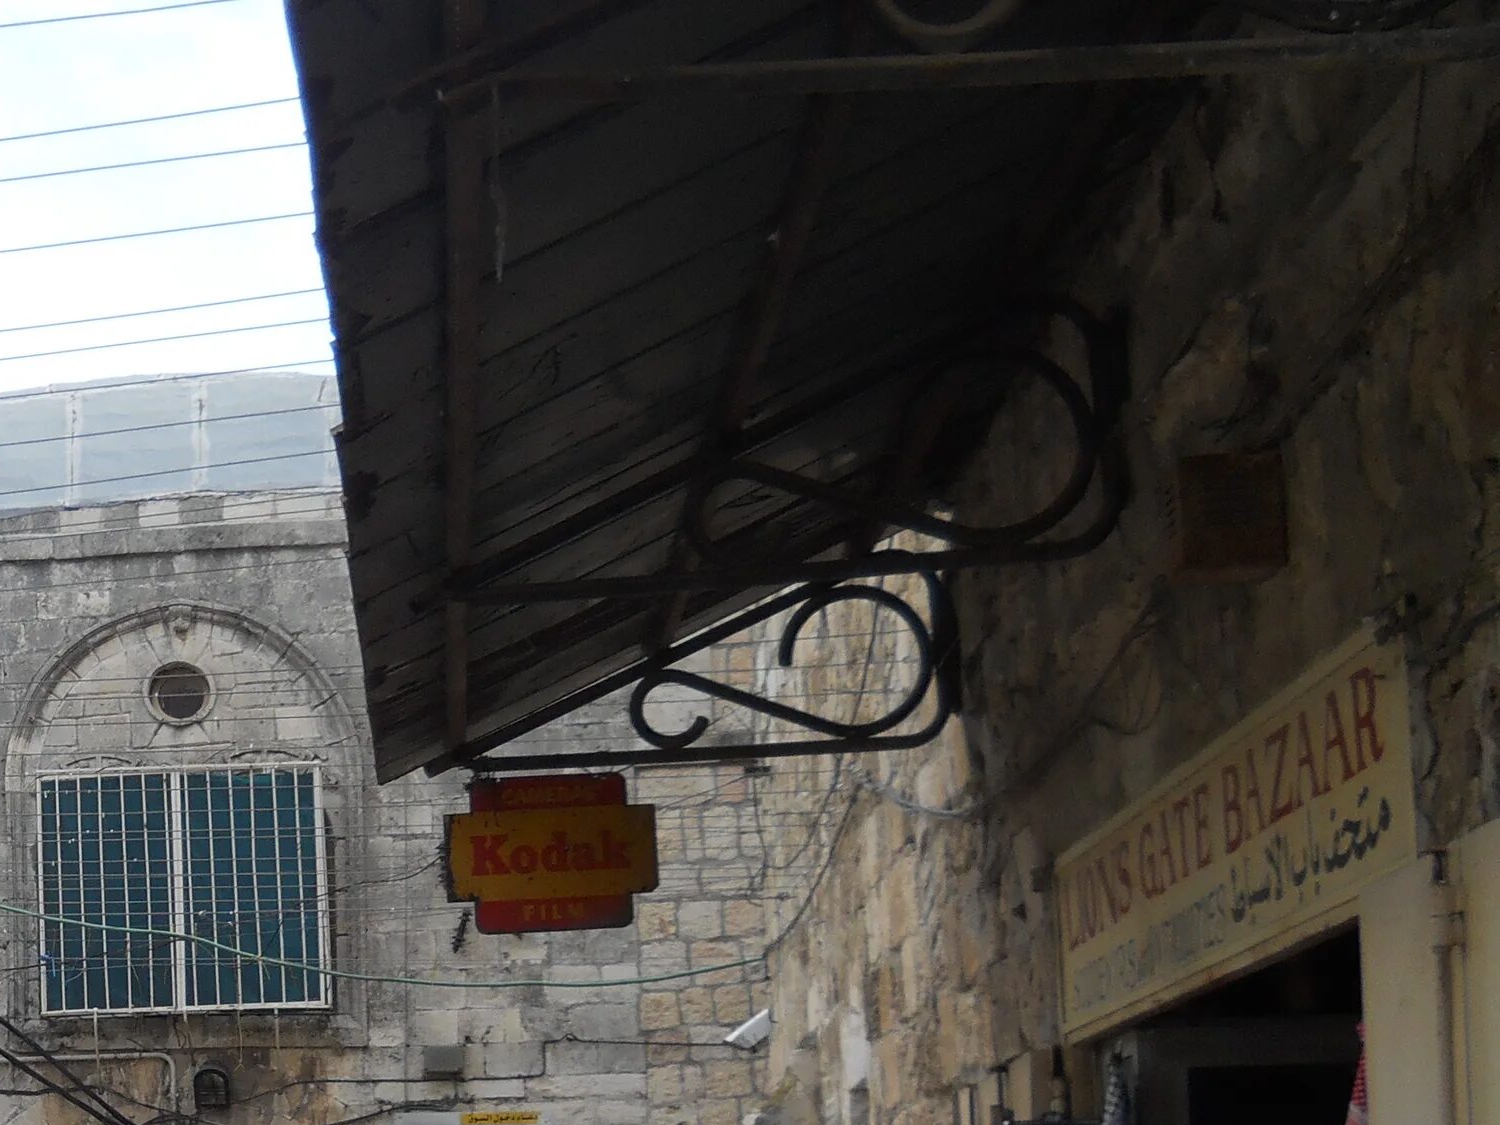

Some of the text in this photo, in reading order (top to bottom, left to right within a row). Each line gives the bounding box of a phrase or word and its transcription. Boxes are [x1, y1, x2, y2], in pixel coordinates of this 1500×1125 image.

[1065, 838, 1132, 952] LIONS
[1138, 783, 1213, 901] GATE
[1221, 666, 1385, 854] BAZAAR
[470, 830, 630, 877] Kodak
[522, 900, 584, 921] FILM
